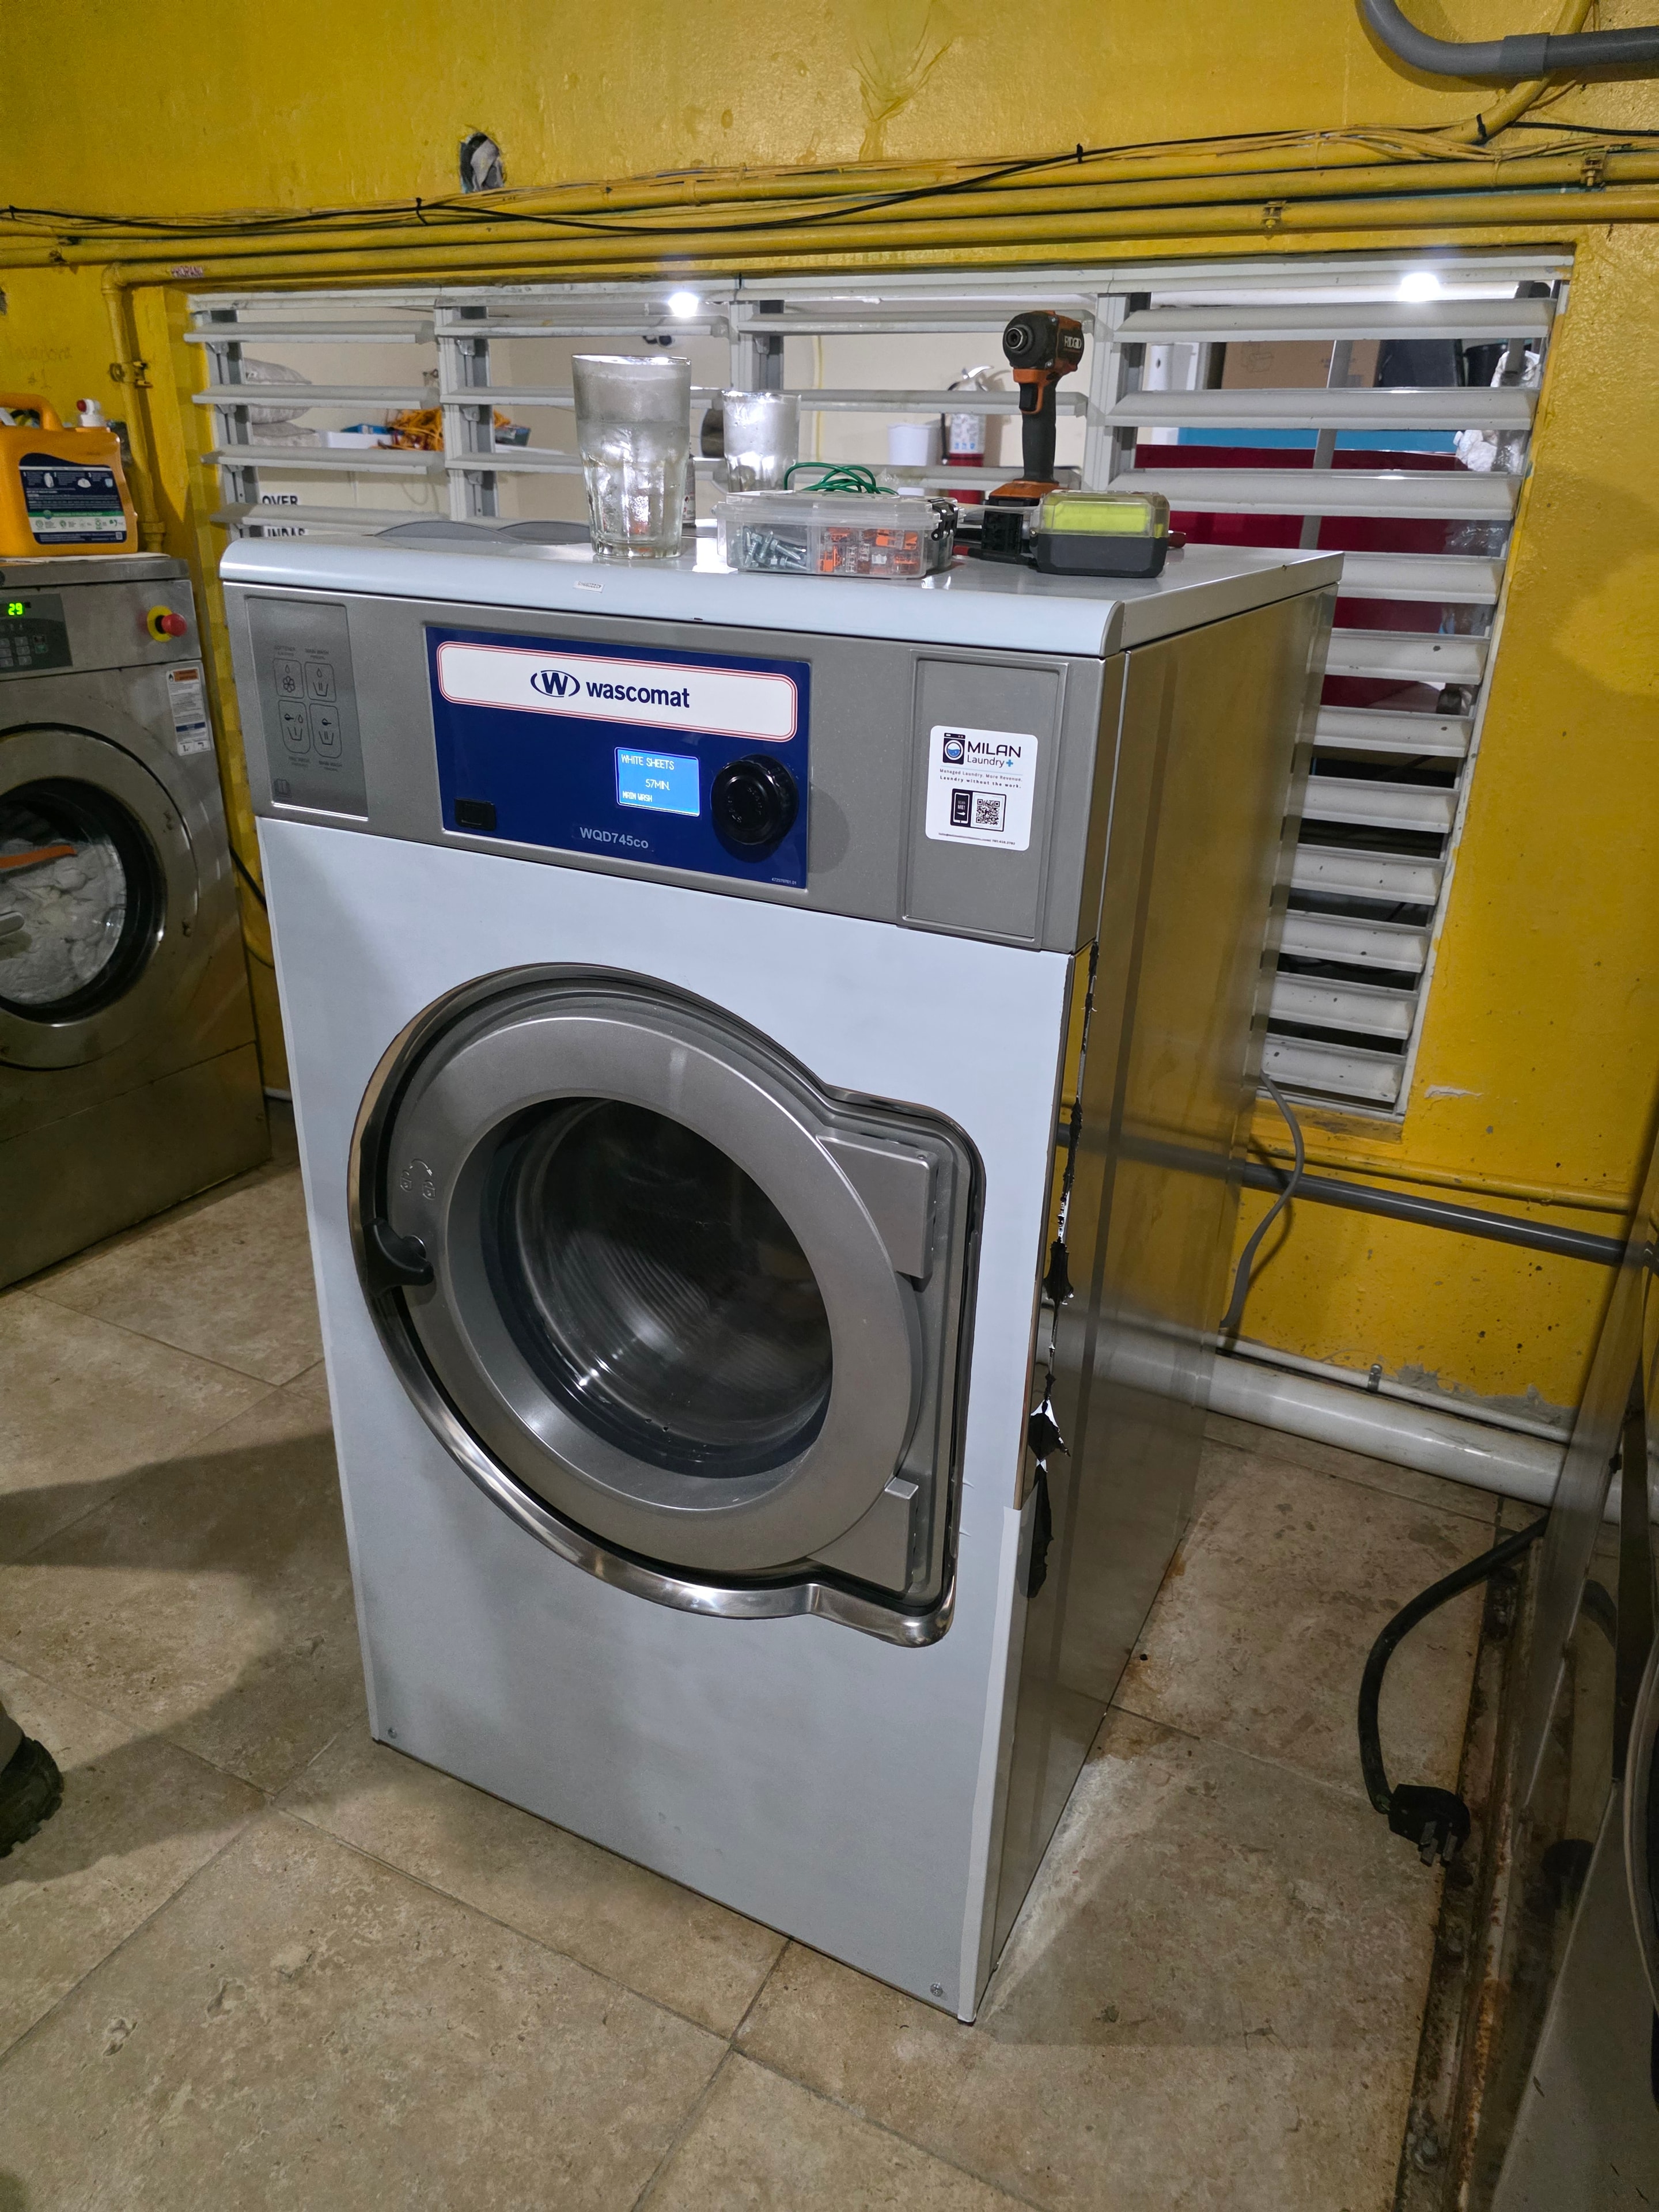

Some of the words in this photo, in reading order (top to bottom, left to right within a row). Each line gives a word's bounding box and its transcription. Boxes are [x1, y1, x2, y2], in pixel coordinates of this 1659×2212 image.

[8, 603, 23, 615] 29
[586, 681, 690, 708] wascomat
[967, 741, 1021, 758] MILAN
[621, 753, 644, 766] WHITE
[646, 757, 675, 770] SHEETS
[622, 790, 637, 800] MAIN
[638, 793, 653, 802] WASH
[579, 827, 649, 849] WQD745co
